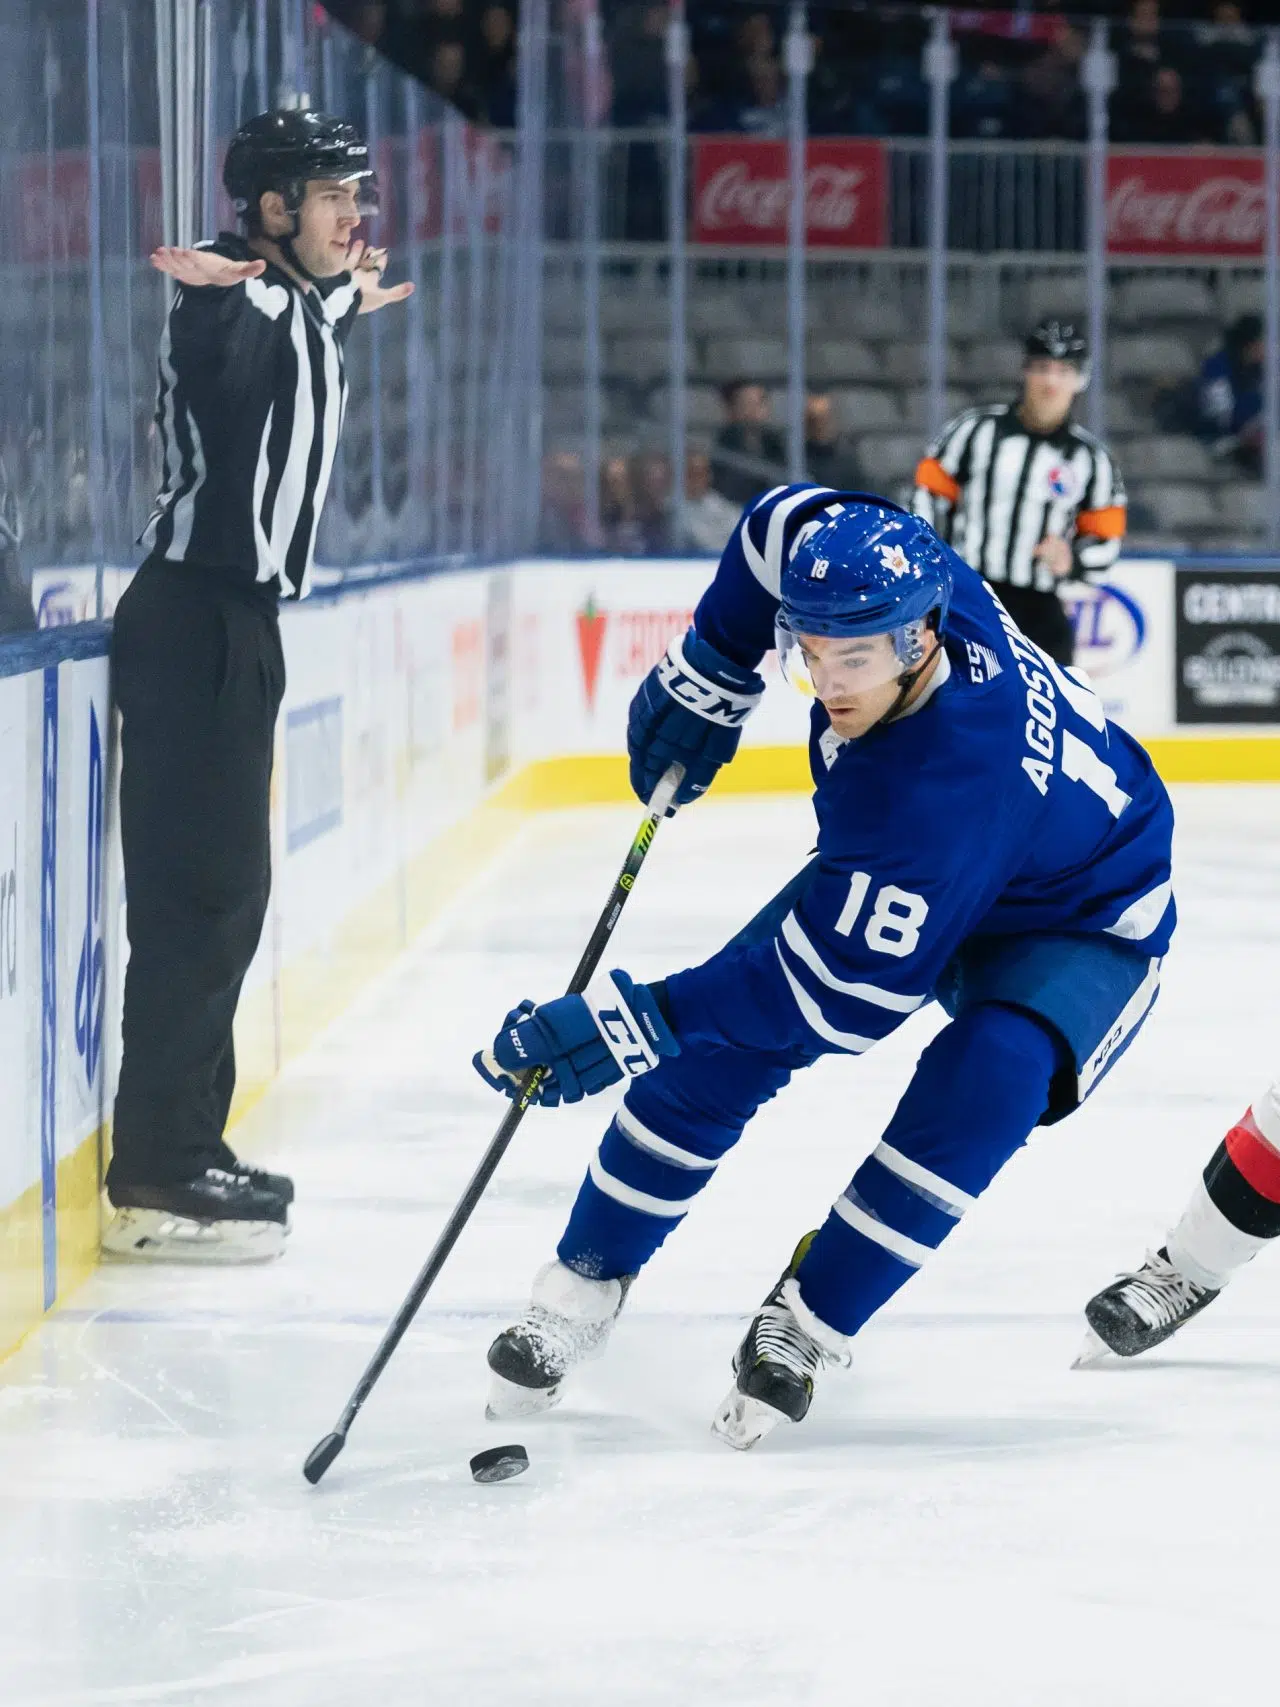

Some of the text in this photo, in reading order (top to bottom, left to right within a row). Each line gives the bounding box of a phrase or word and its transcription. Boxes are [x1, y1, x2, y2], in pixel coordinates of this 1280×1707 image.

[810, 558, 830, 580] 18
[833, 870, 930, 958] 18
[509, 1028, 528, 1059] CCM
